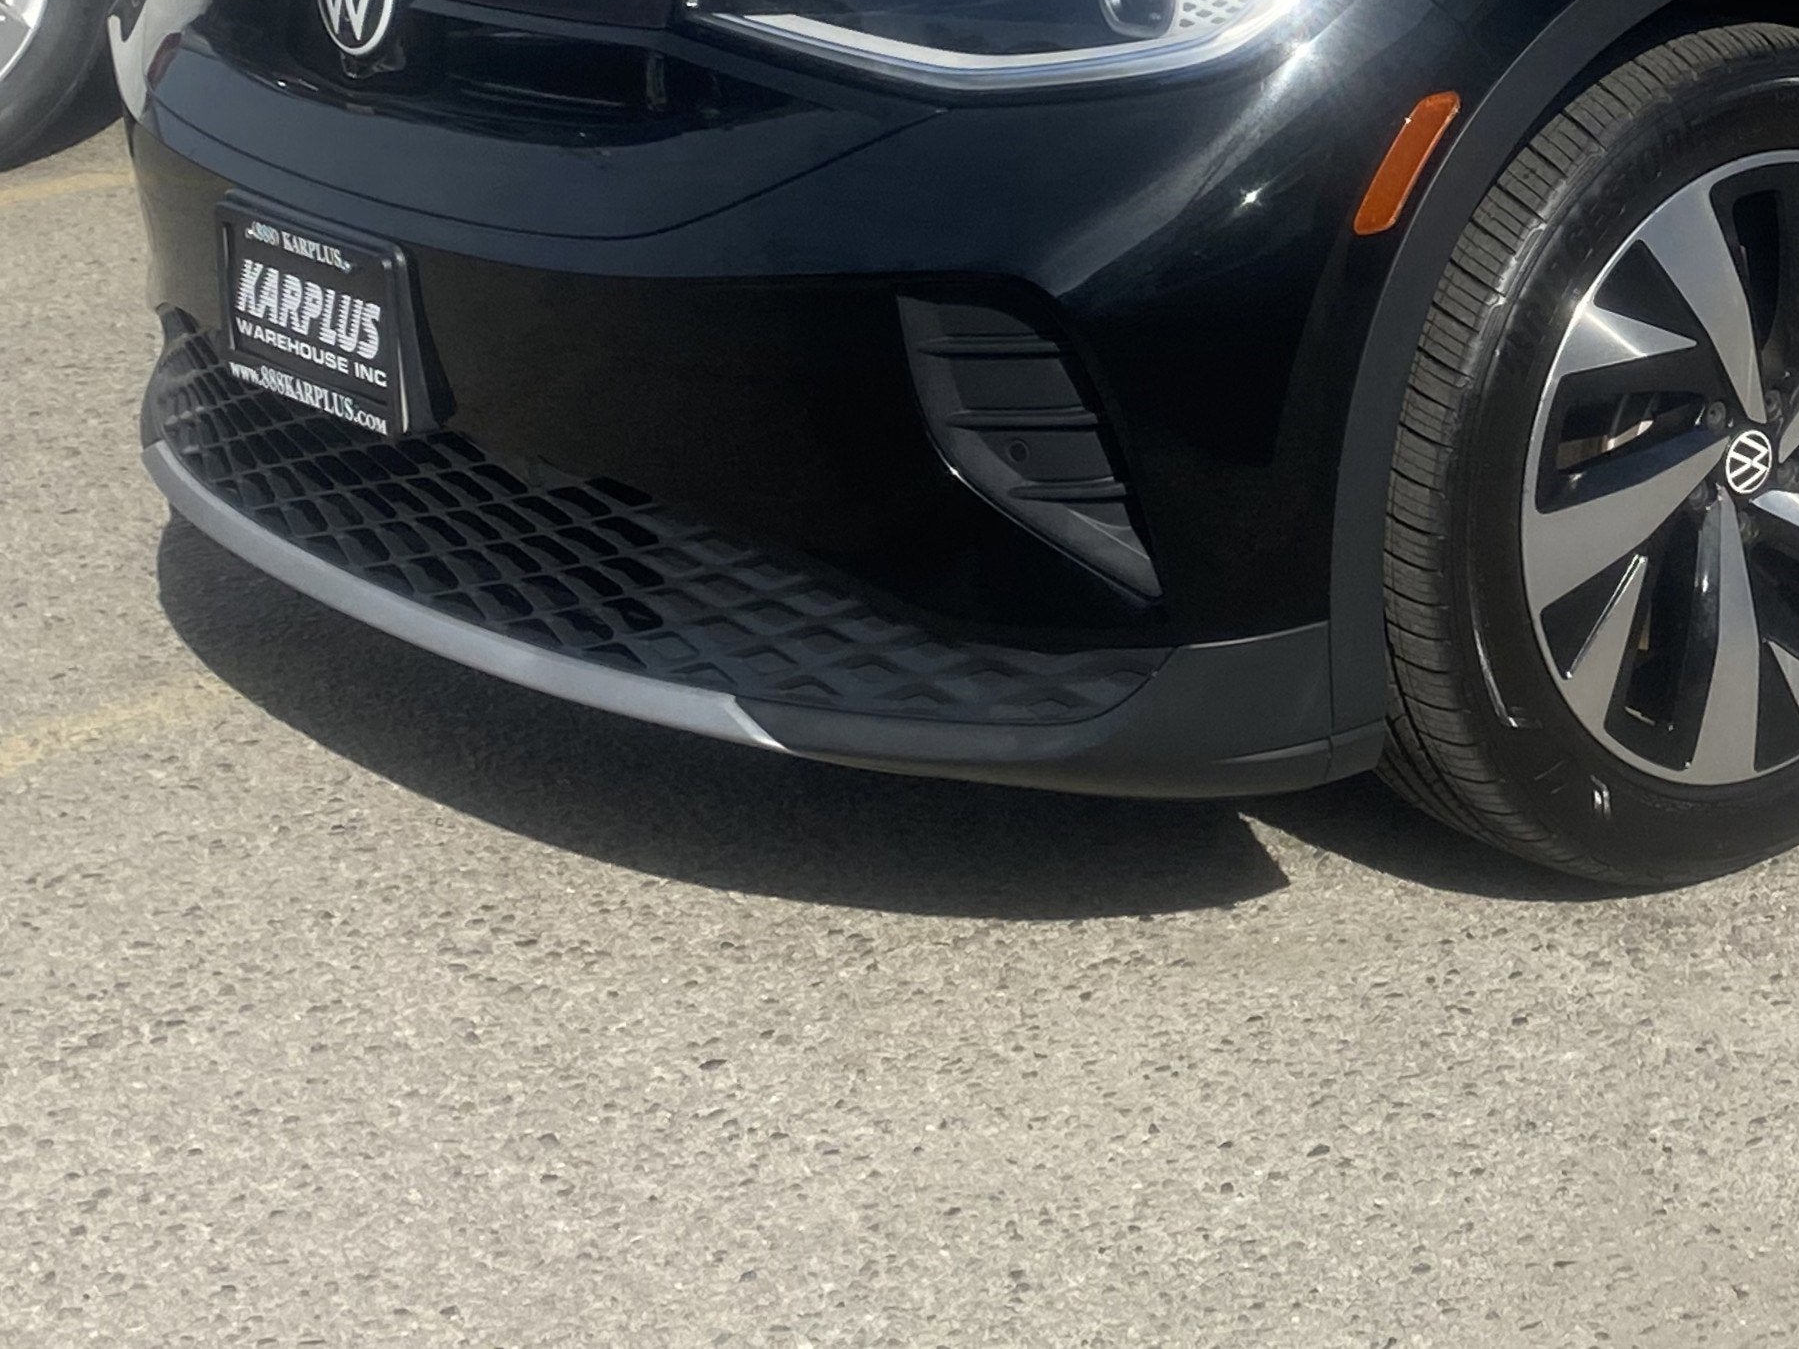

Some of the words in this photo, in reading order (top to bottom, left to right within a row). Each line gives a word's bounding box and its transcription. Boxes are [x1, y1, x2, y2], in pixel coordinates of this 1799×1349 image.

[281, 230, 346, 270] KARPLUS
[235, 258, 381, 360] KARPLUS
[235, 316, 349, 375] WAREHOUSE
[353, 361, 388, 388] INC
